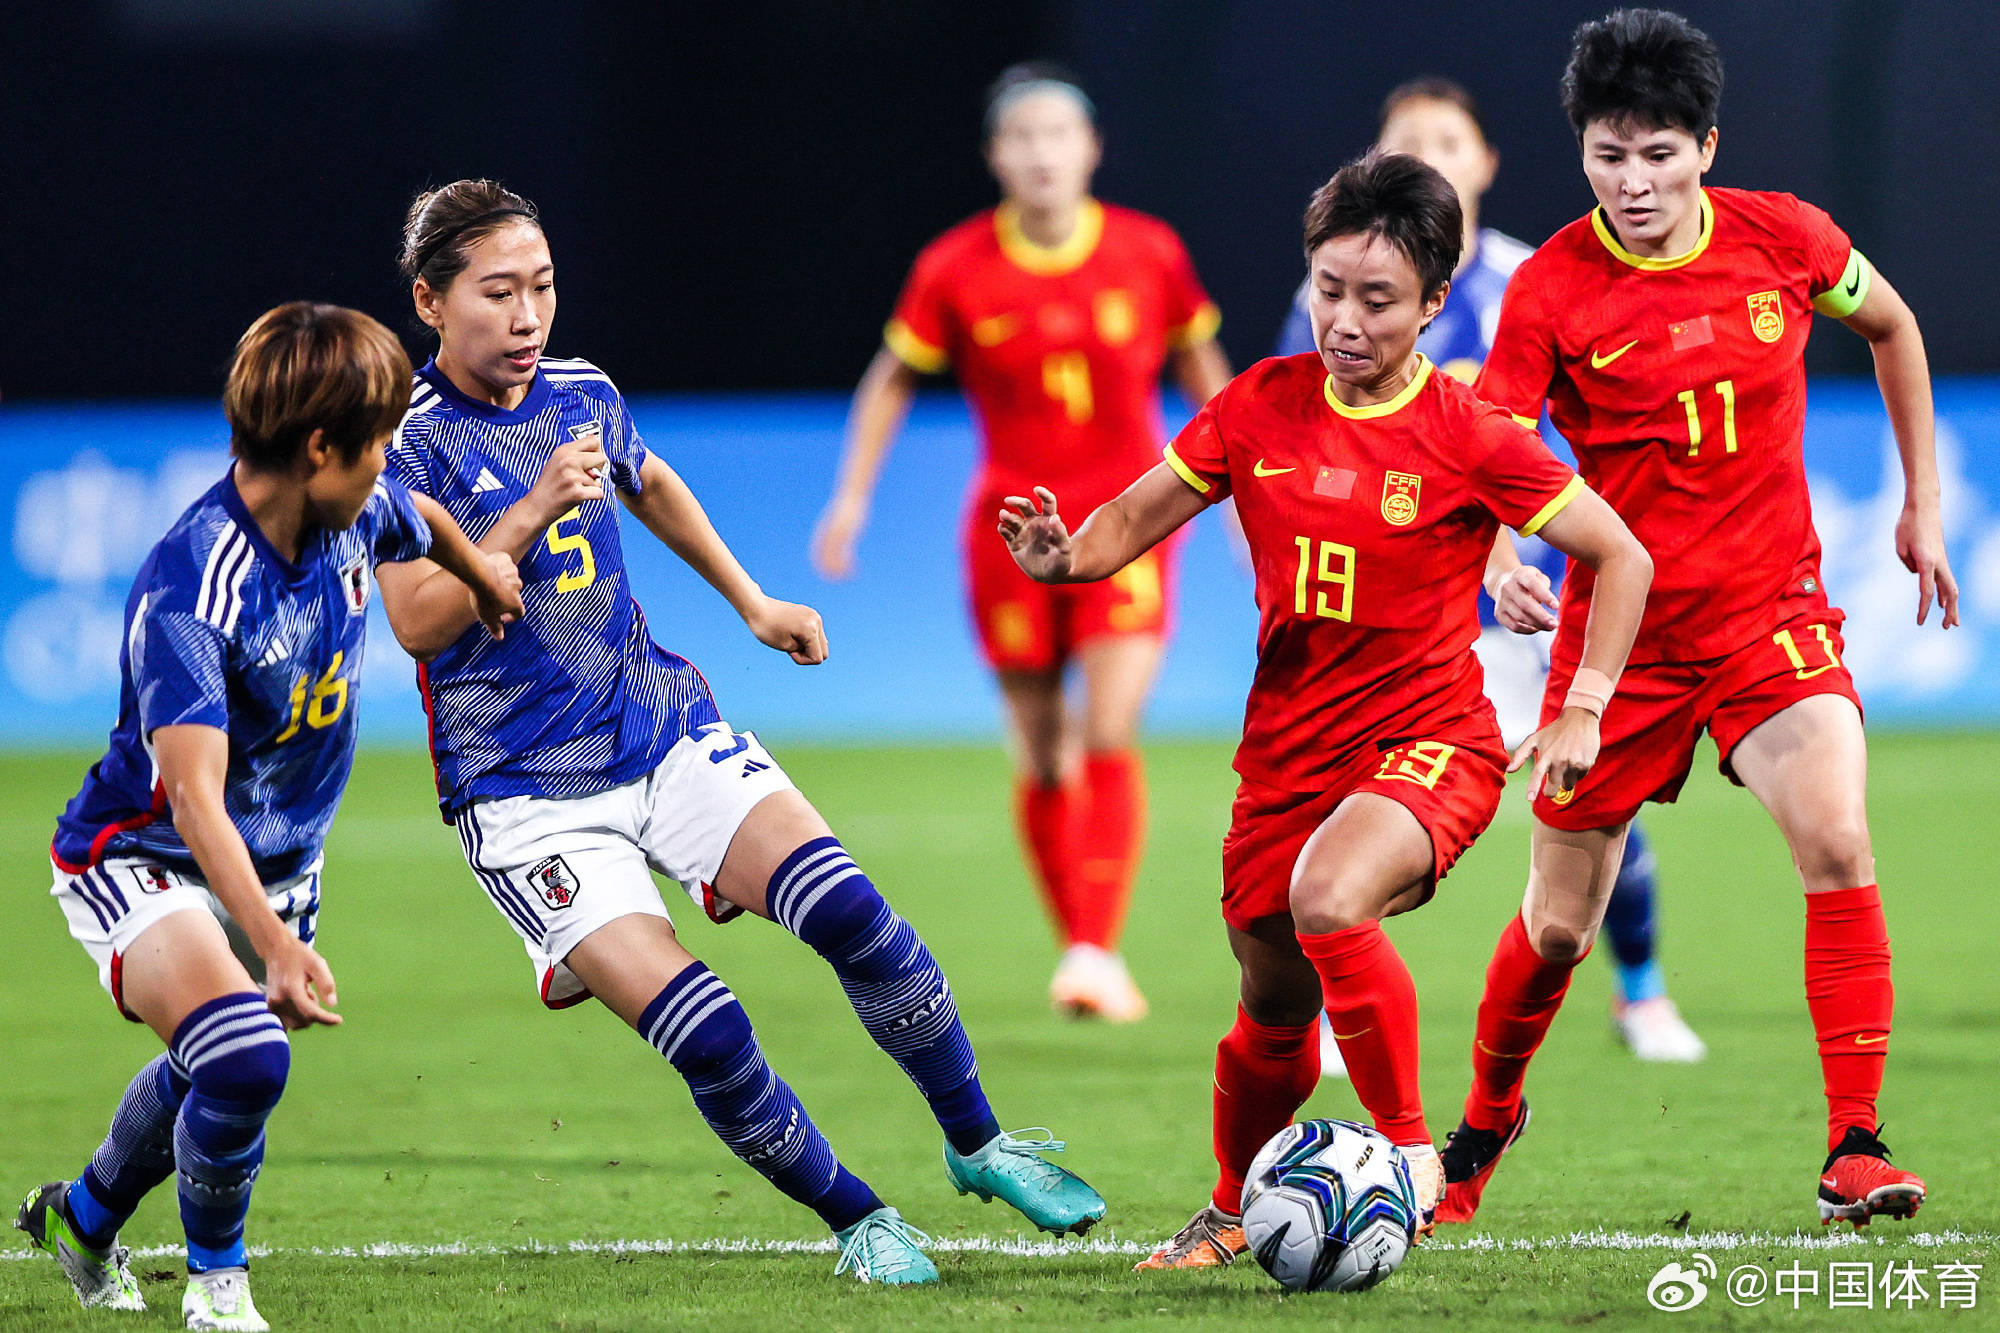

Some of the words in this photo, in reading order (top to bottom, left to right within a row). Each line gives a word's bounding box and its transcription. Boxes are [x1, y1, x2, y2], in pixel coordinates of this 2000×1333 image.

[1750, 293, 1778, 308] CFA
[1042, 350, 1095, 425] 4
[1677, 379, 1738, 457] 11
[1388, 474, 1418, 489] CFA
[546, 506, 597, 594] 5
[1294, 535, 1356, 623] 19
[276, 649, 348, 744] 16
[893, 975, 949, 1032] JAPA
